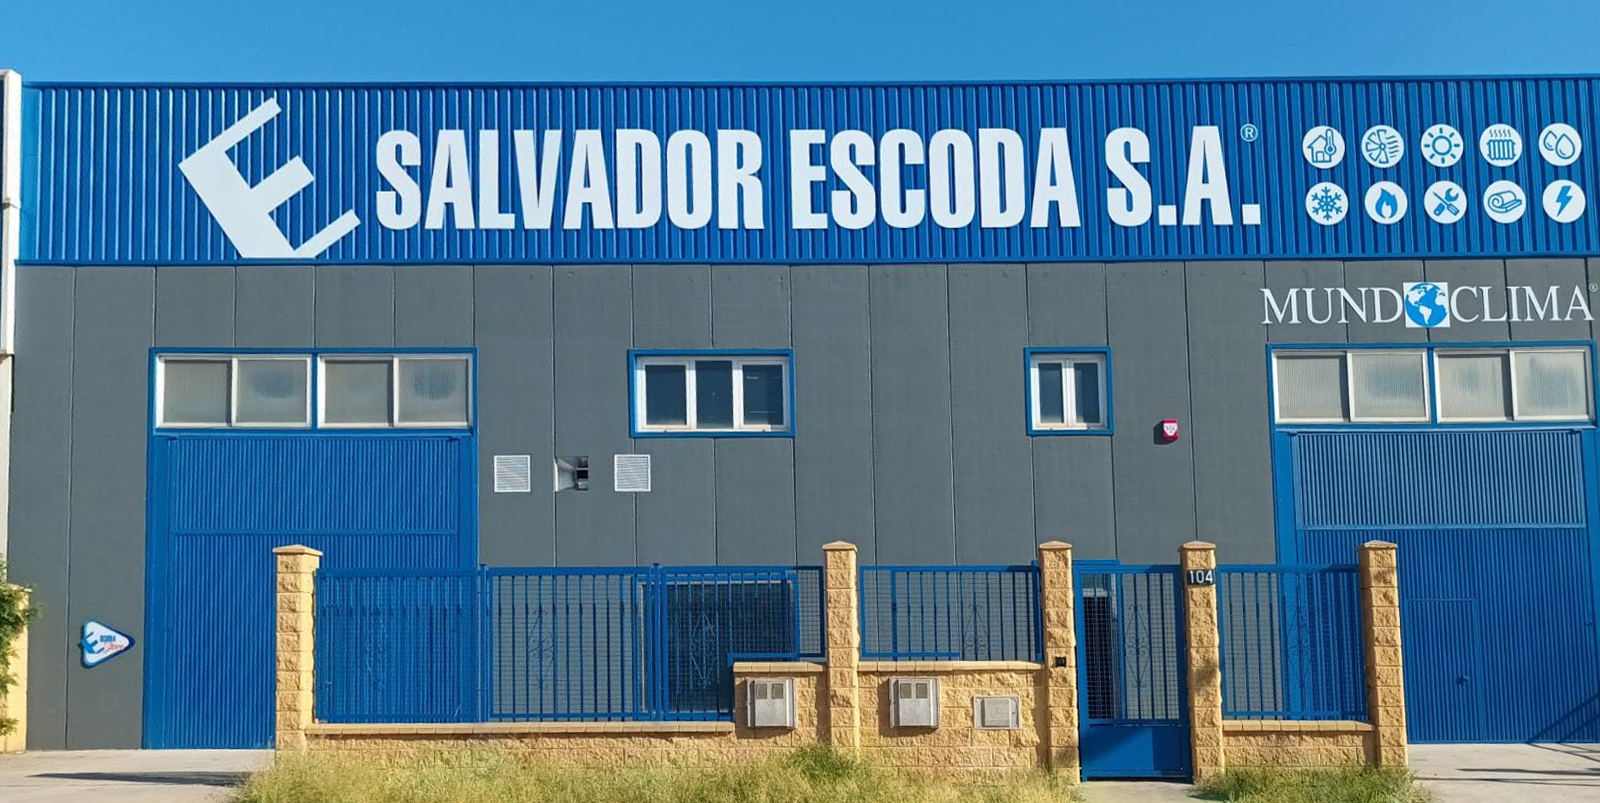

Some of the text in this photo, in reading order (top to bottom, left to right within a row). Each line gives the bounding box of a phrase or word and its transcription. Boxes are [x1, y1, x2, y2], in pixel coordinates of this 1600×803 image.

[376, 129, 765, 230] SALVADOR
[790, 127, 1081, 229] ESCODA
[1105, 126, 1261, 227] S.A.
[1190, 569, 1214, 584] 104
